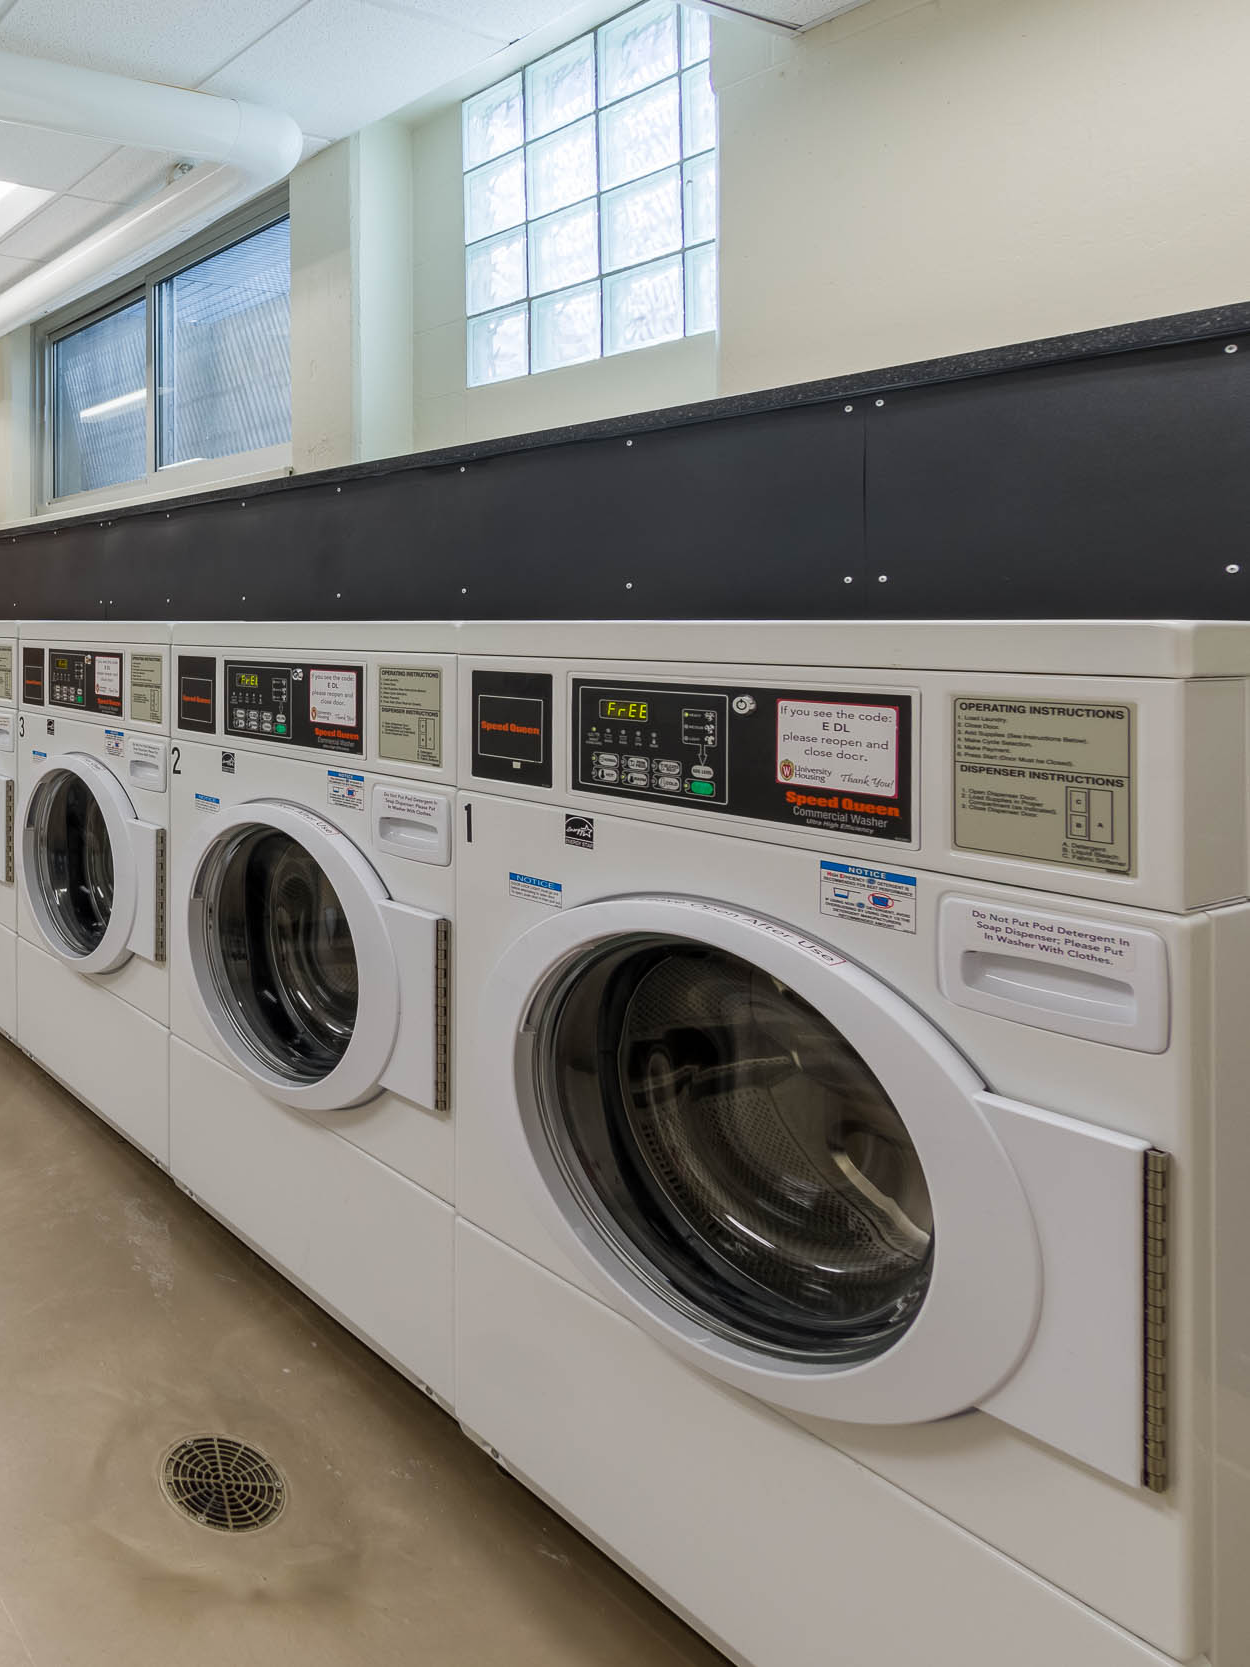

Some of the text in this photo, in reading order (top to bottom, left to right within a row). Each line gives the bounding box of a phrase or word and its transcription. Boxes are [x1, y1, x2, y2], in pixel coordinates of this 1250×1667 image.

[780, 705, 892, 723] If you see the code:
[959, 702, 1125, 720] OPERATING INSTRUCTIONS
[19, 716, 25, 737] 3
[481, 720, 540, 735] Speed Queen
[822, 722, 850, 733] E DL
[783, 732, 889, 750] please reopen and
[171, 747, 182, 775] 2
[804, 746, 868, 762] close door.
[794, 764, 832, 777] University
[794, 771, 826, 783] Housing
[960, 764, 1125, 788] DISPENSER INSTRUCTIONS
[840, 773, 894, 789] Thank You!
[785, 791, 900, 817] Speed Queen
[464, 803, 473, 843] 1
[792, 805, 889, 828] Commercial Washer
[848, 867, 886, 879] NOTICE
[516, 875, 555, 890] NOTICE
[972, 910, 1130, 947] Do Not Put Pod Detergent In
[742, 918, 794, 938] After
[798, 940, 834, 962] Use
[976, 921, 1002, 933] Soap
[1064, 938, 1100, 952] Please
[1104, 945, 1124, 956] Put
[984, 932, 1114, 965] In Washer With Clothes.
